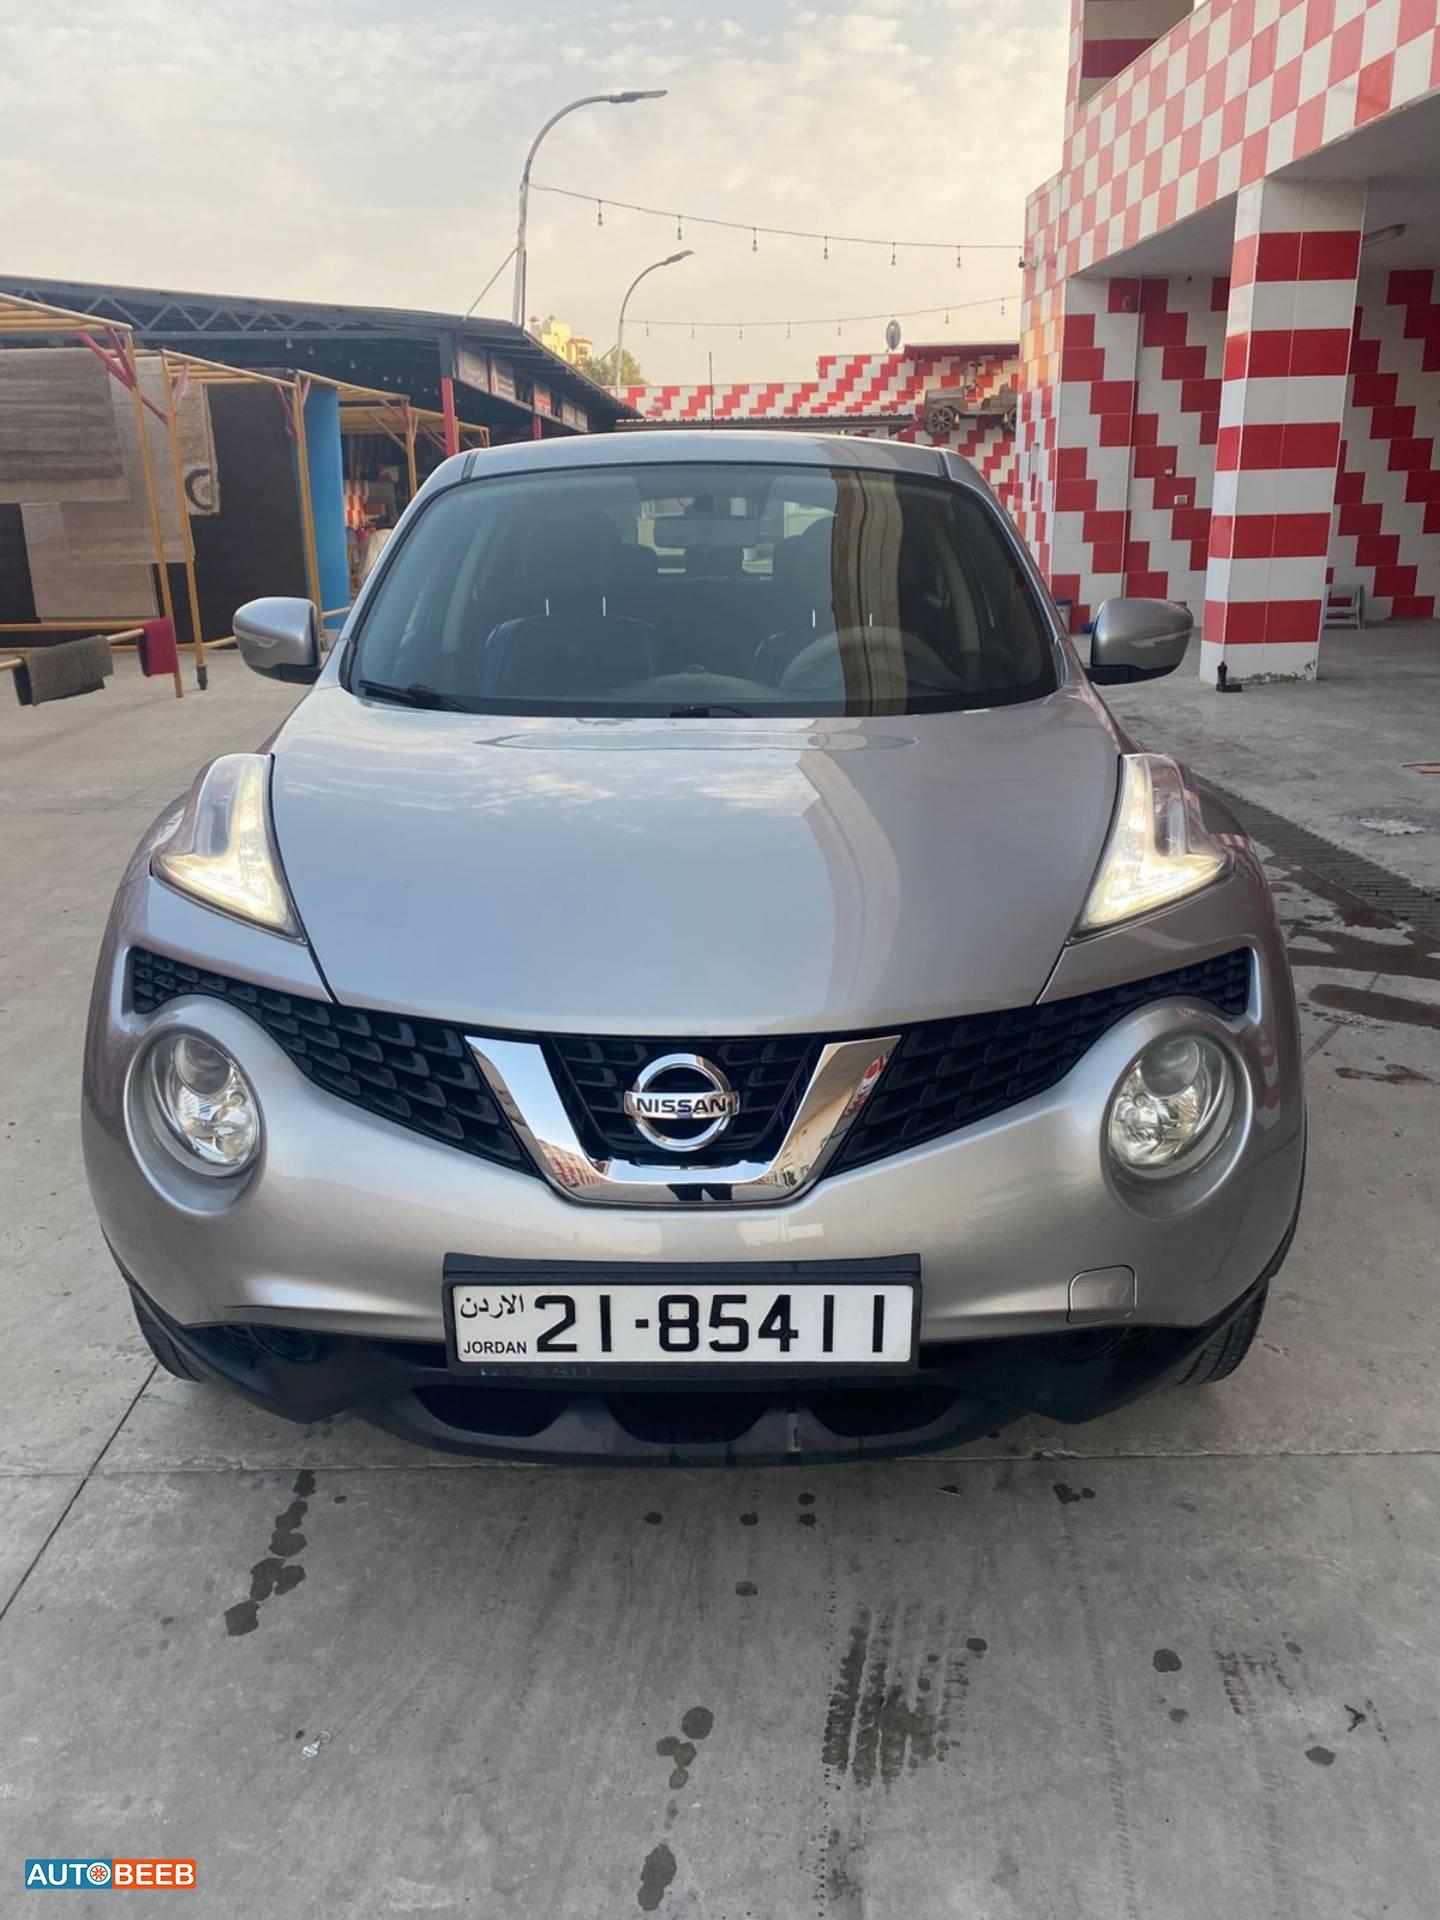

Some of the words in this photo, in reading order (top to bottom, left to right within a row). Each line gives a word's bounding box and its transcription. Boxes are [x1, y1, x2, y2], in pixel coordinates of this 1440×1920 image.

[636, 1097, 727, 1113] NISSAN
[460, 1294, 524, 1319] الاردن
[534, 1294, 885, 1353] 21-85411
[463, 1341, 527, 1354] JORDAN
